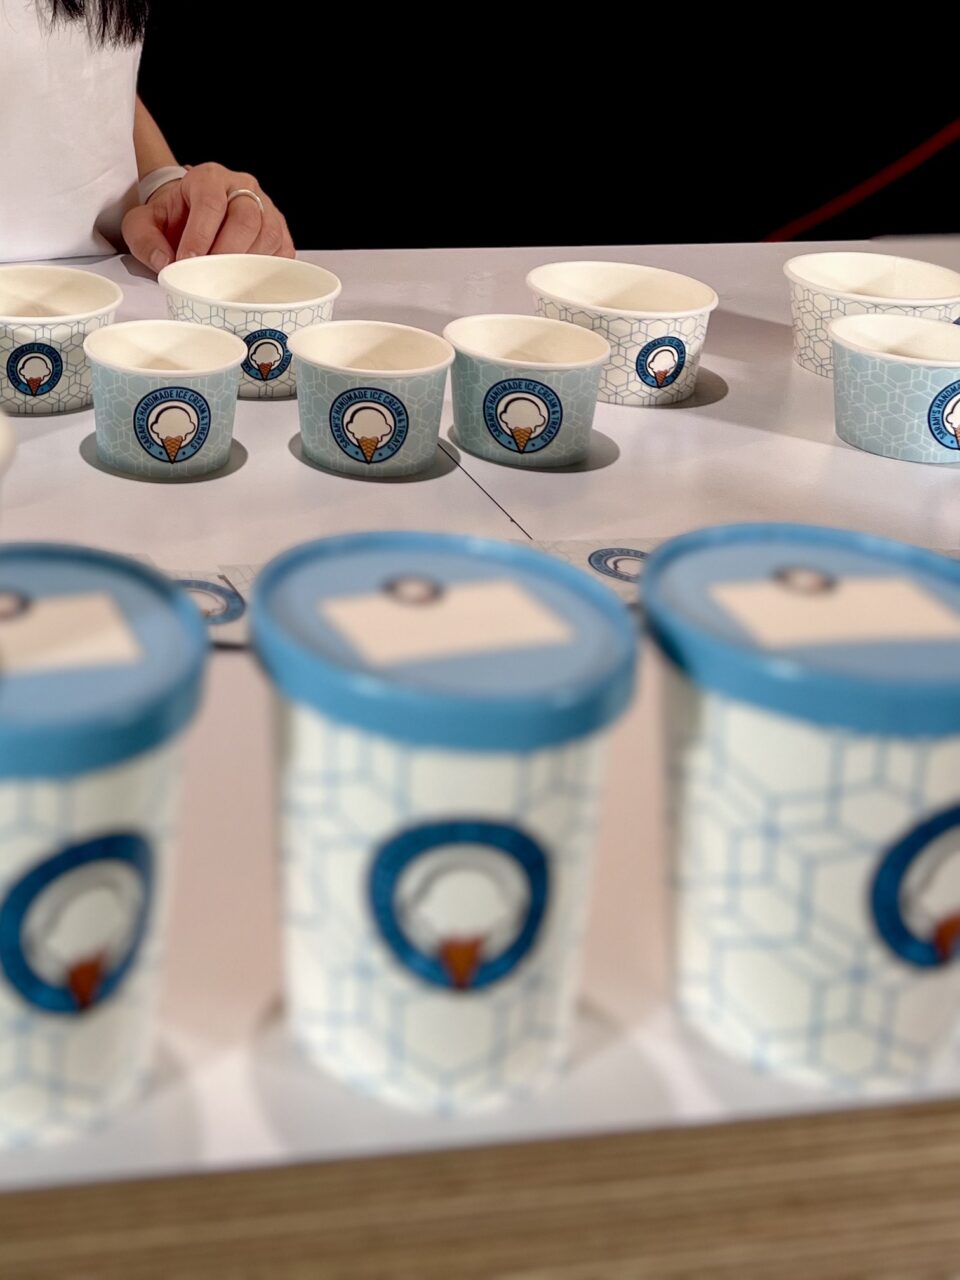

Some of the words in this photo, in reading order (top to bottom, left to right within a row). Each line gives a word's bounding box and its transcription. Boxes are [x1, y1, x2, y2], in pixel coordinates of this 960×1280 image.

[139, 389, 175, 416] HANDMADE
[176, 390, 189, 400] ICE
[188, 393, 208, 414] CREAM
[334, 390, 369, 416] HANDMADE
[369, 391, 383, 400] ICE
[383, 395, 404, 418] CREAM
[487, 381, 523, 405] HANDMADE
[524, 382, 538, 392] ICE
[537, 387, 558, 409] CREAM
